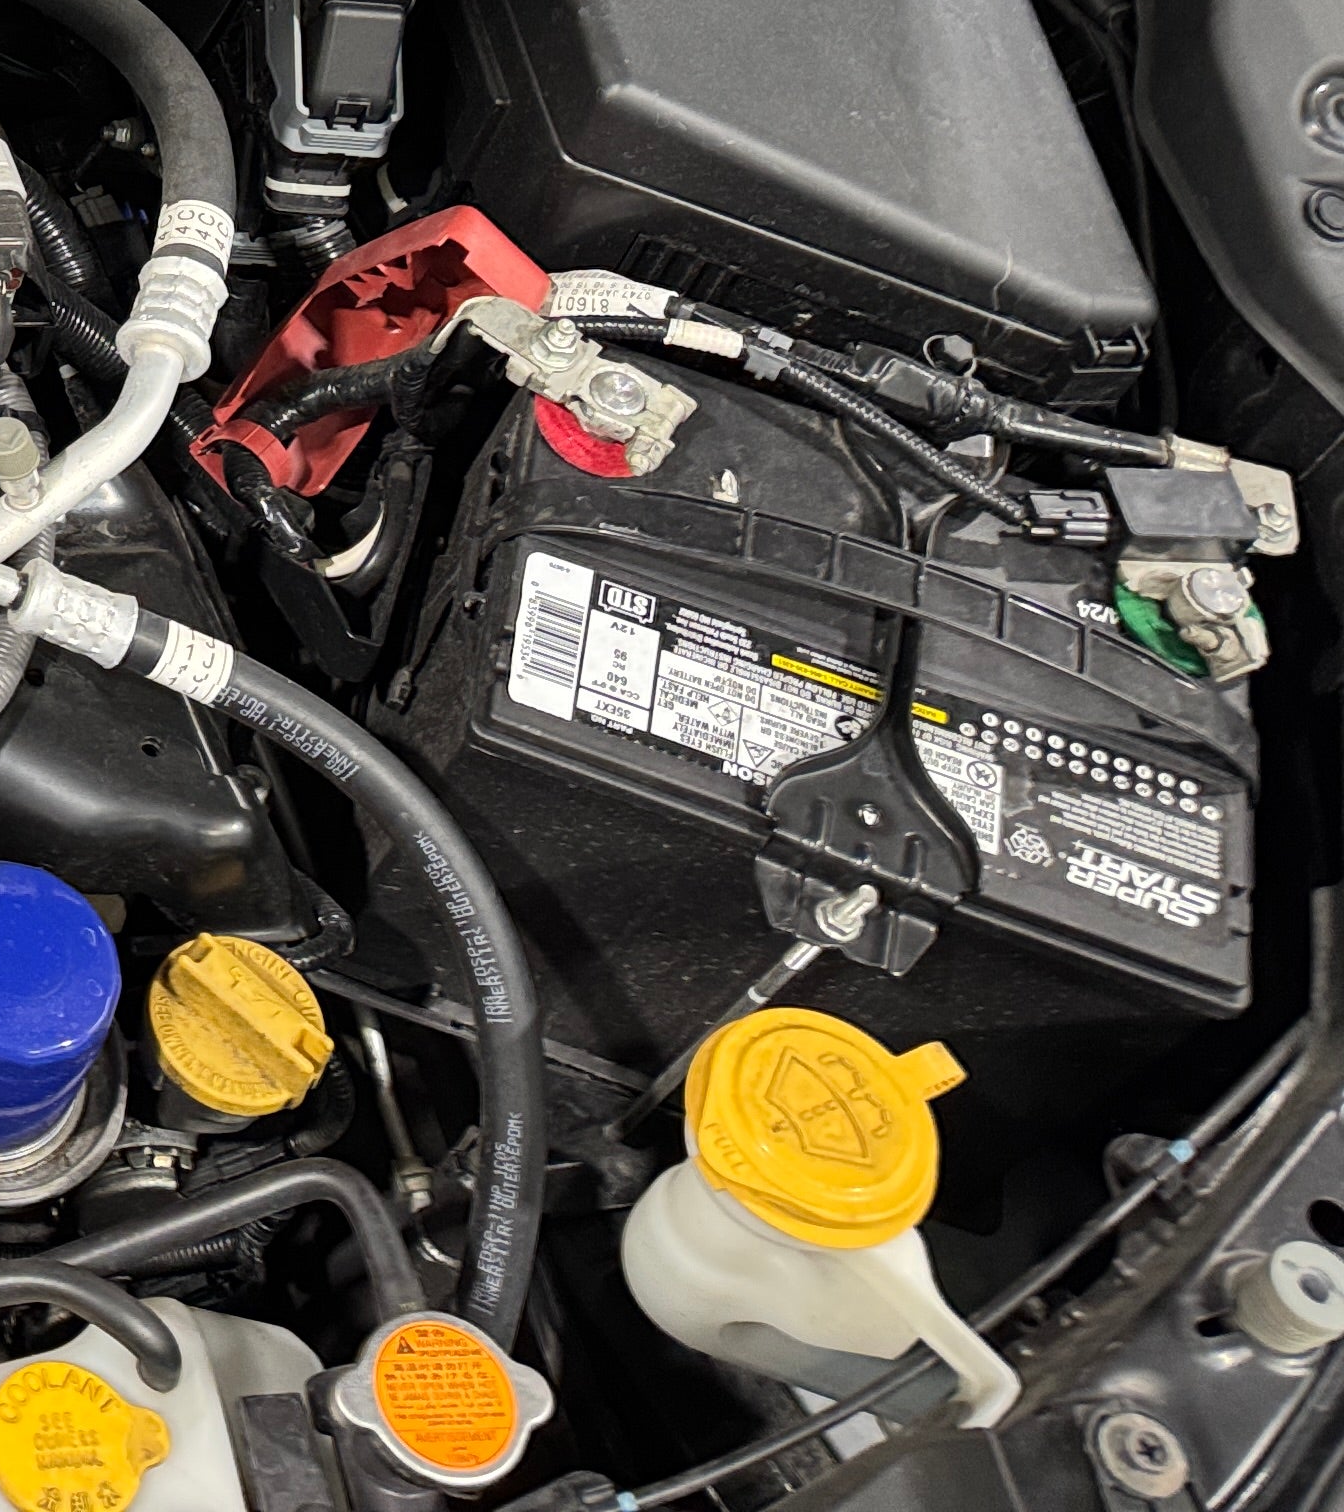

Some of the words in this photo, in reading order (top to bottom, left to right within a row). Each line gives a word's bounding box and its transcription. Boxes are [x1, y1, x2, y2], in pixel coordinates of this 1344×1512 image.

[583, 286, 618, 298] JAPAN
[557, 293, 609, 315] 81601
[604, 585, 651, 616] STD
[609, 620, 636, 636] 12V
[605, 671, 628, 686] 640
[703, 679, 725, 693] OPEN
[619, 688, 640, 700] CCA
[657, 688, 698, 709] MEDICAL
[685, 688, 710, 703] HELP
[594, 698, 632, 719] 35EXT
[672, 721, 735, 749] IMMEDIATELY
[678, 733, 701, 747] EYES
[711, 725, 735, 739] WITH
[704, 743, 733, 759] FLUSH
[1066, 849, 1221, 915] START
[1066, 864, 1200, 927] SUPER
[704, 1122, 751, 1175] PULL
